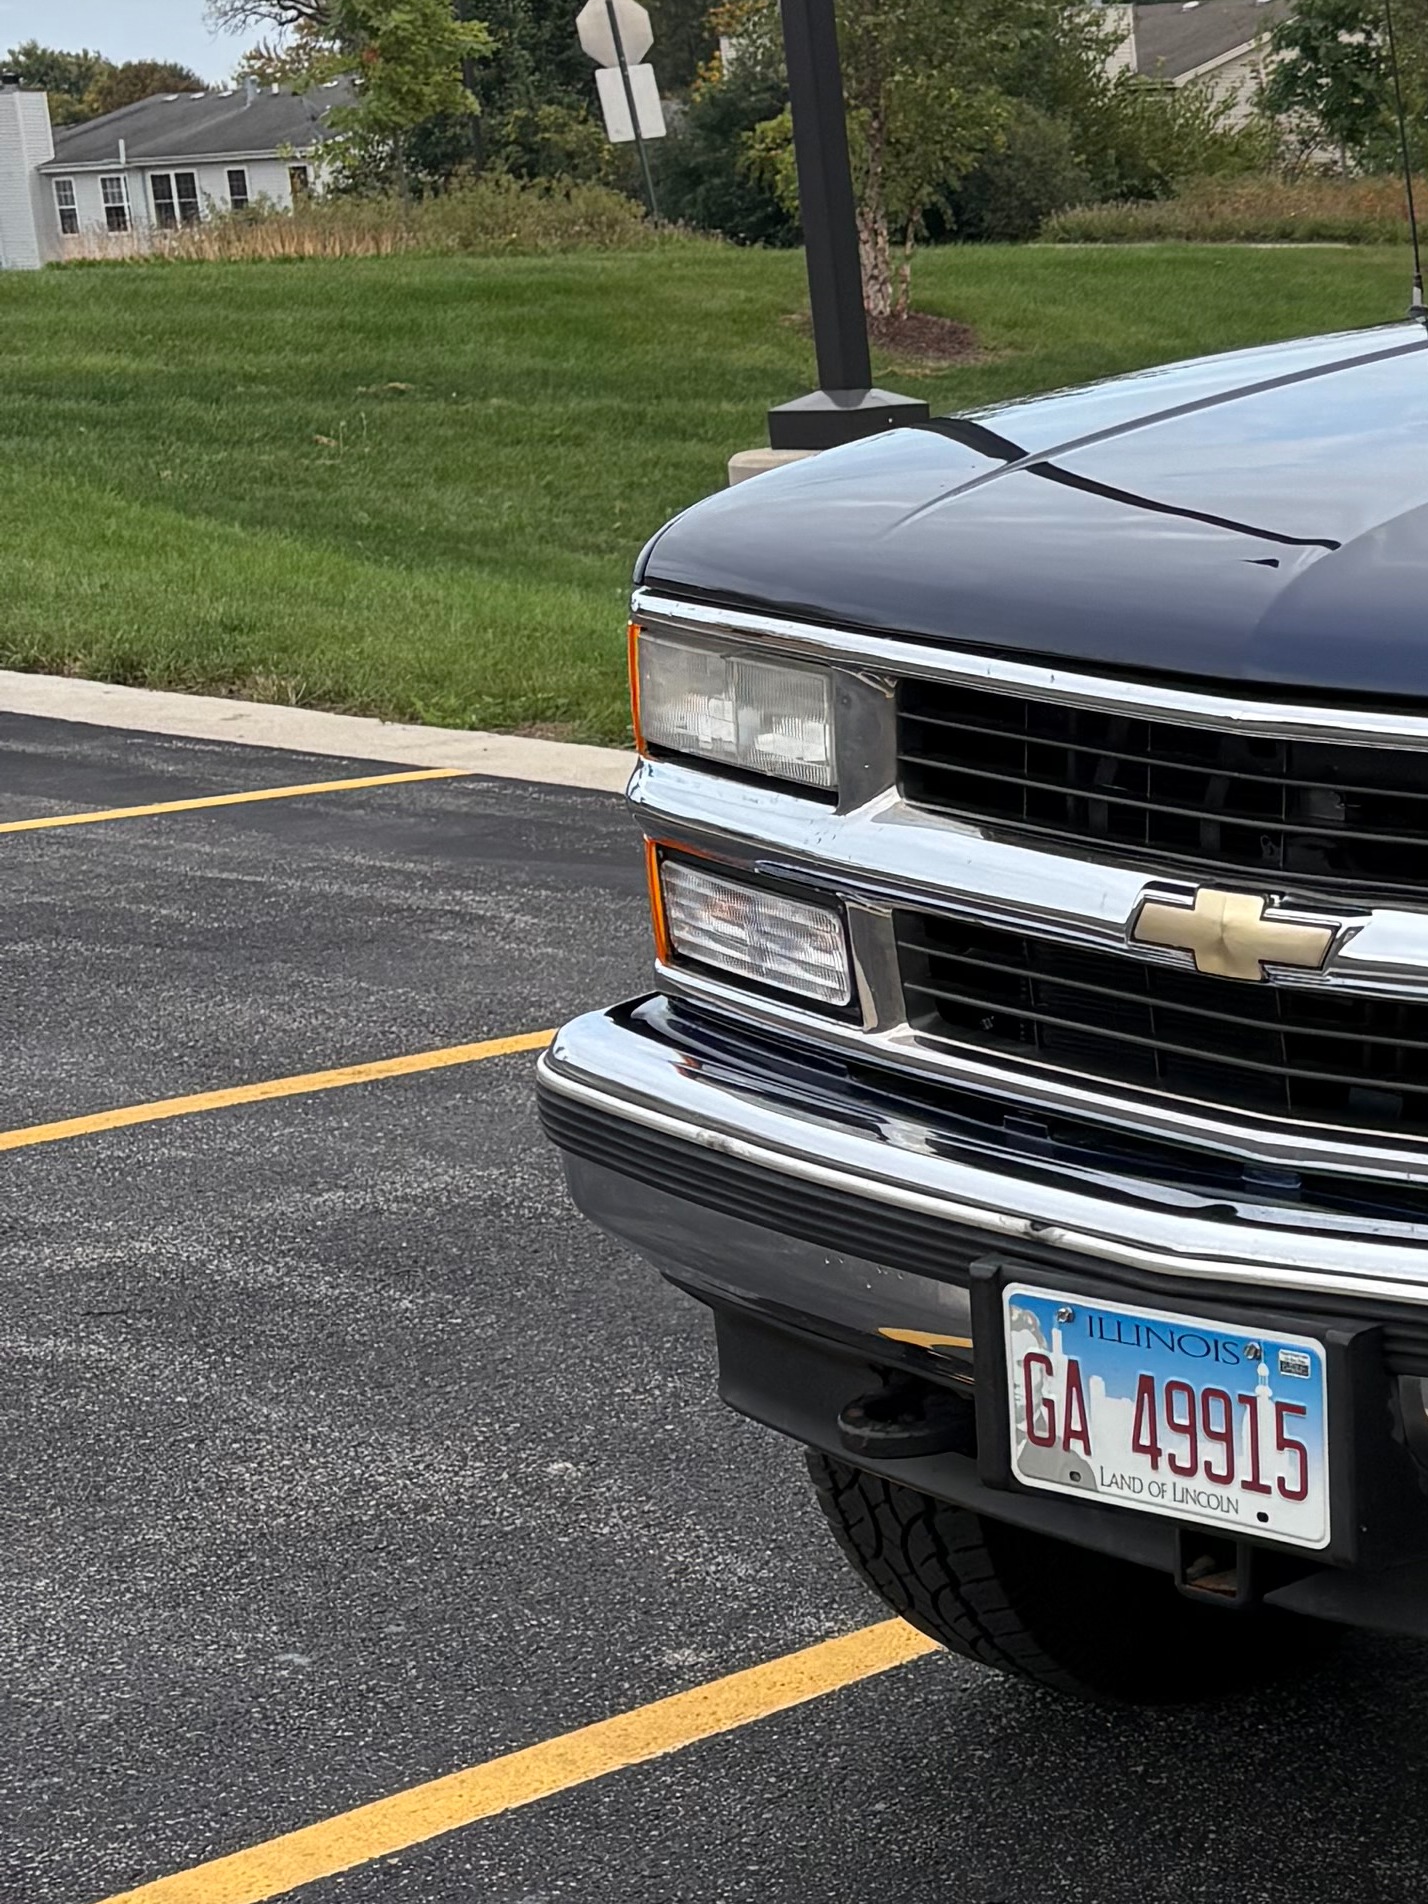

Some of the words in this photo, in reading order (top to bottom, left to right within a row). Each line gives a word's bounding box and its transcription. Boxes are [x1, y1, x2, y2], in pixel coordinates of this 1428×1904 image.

[1088, 1314, 1240, 1365] ILLINOIS
[1023, 1352, 1092, 1456] GA
[1132, 1374, 1308, 1501] 49915
[1100, 1465, 1144, 1493] LAND
[1148, 1480, 1168, 1500] OF
[1173, 1481, 1239, 1514] LINCOLN
